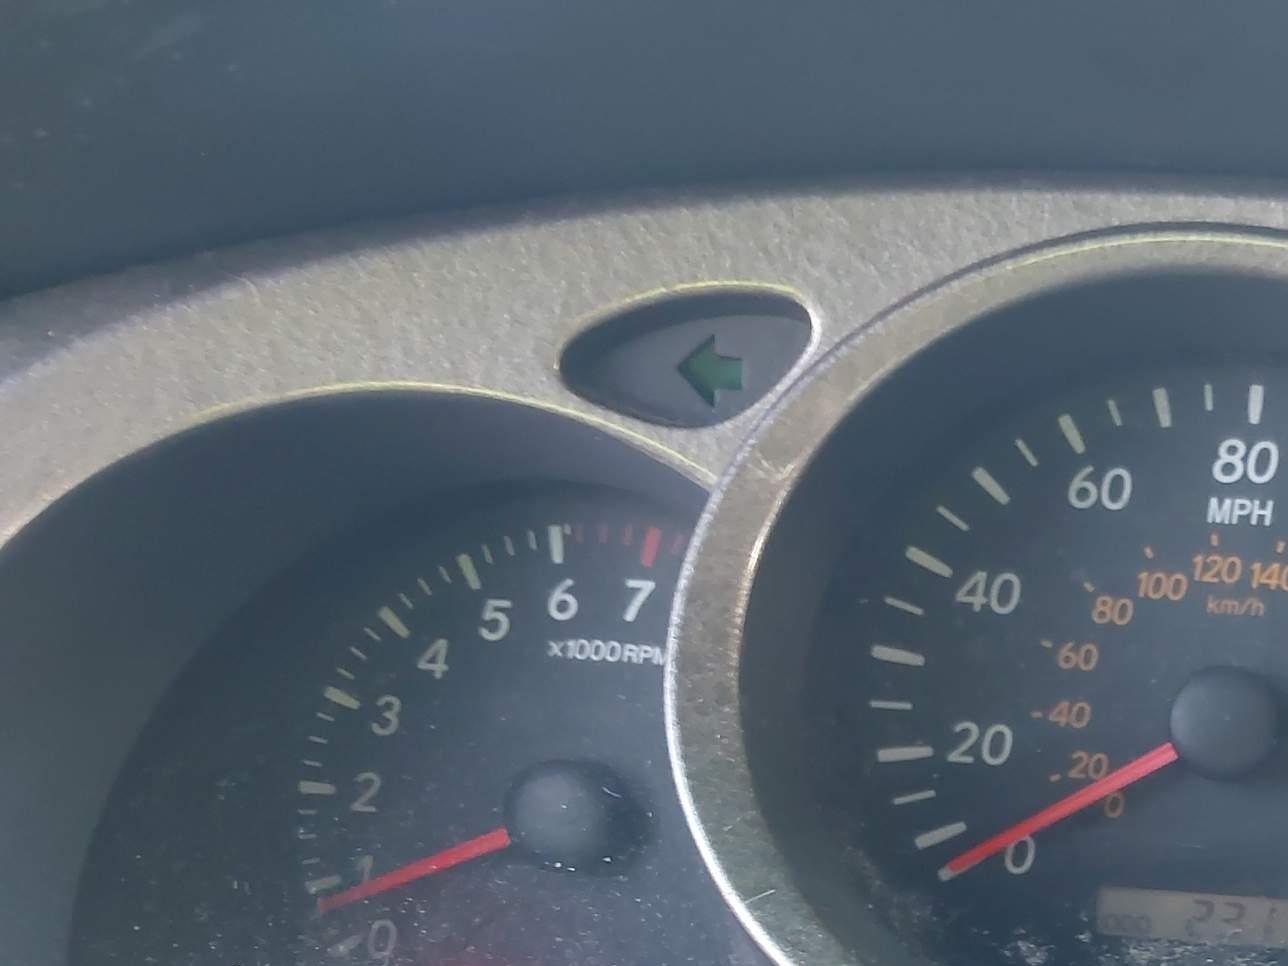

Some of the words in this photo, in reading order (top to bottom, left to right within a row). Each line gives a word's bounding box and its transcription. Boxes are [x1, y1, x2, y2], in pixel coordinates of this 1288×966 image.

[1212, 439, 1279, 484] 80
[1067, 466, 1132, 510] 60
[1207, 497, 1274, 526] MPH
[1137, 571, 1188, 601] 100
[1192, 554, 1242, 584] 120
[547, 578, 578, 621] 6
[624, 578, 656, 622] 7
[955, 571, 1021, 614] 40
[1091, 596, 1134, 625] 80
[1206, 595, 1265, 617] km/h
[479, 600, 512, 640] 5
[417, 638, 449, 679] 4
[1057, 643, 1099, 671] 60
[371, 696, 400, 736] 3
[1048, 702, 1092, 729] 40
[947, 721, 1013, 766] 20
[1068, 751, 1109, 779] 20
[351, 772, 382, 813] 2
[1103, 791, 1125, 819] 0
[1004, 835, 1035, 875] 0
[368, 920, 397, 960] 0
